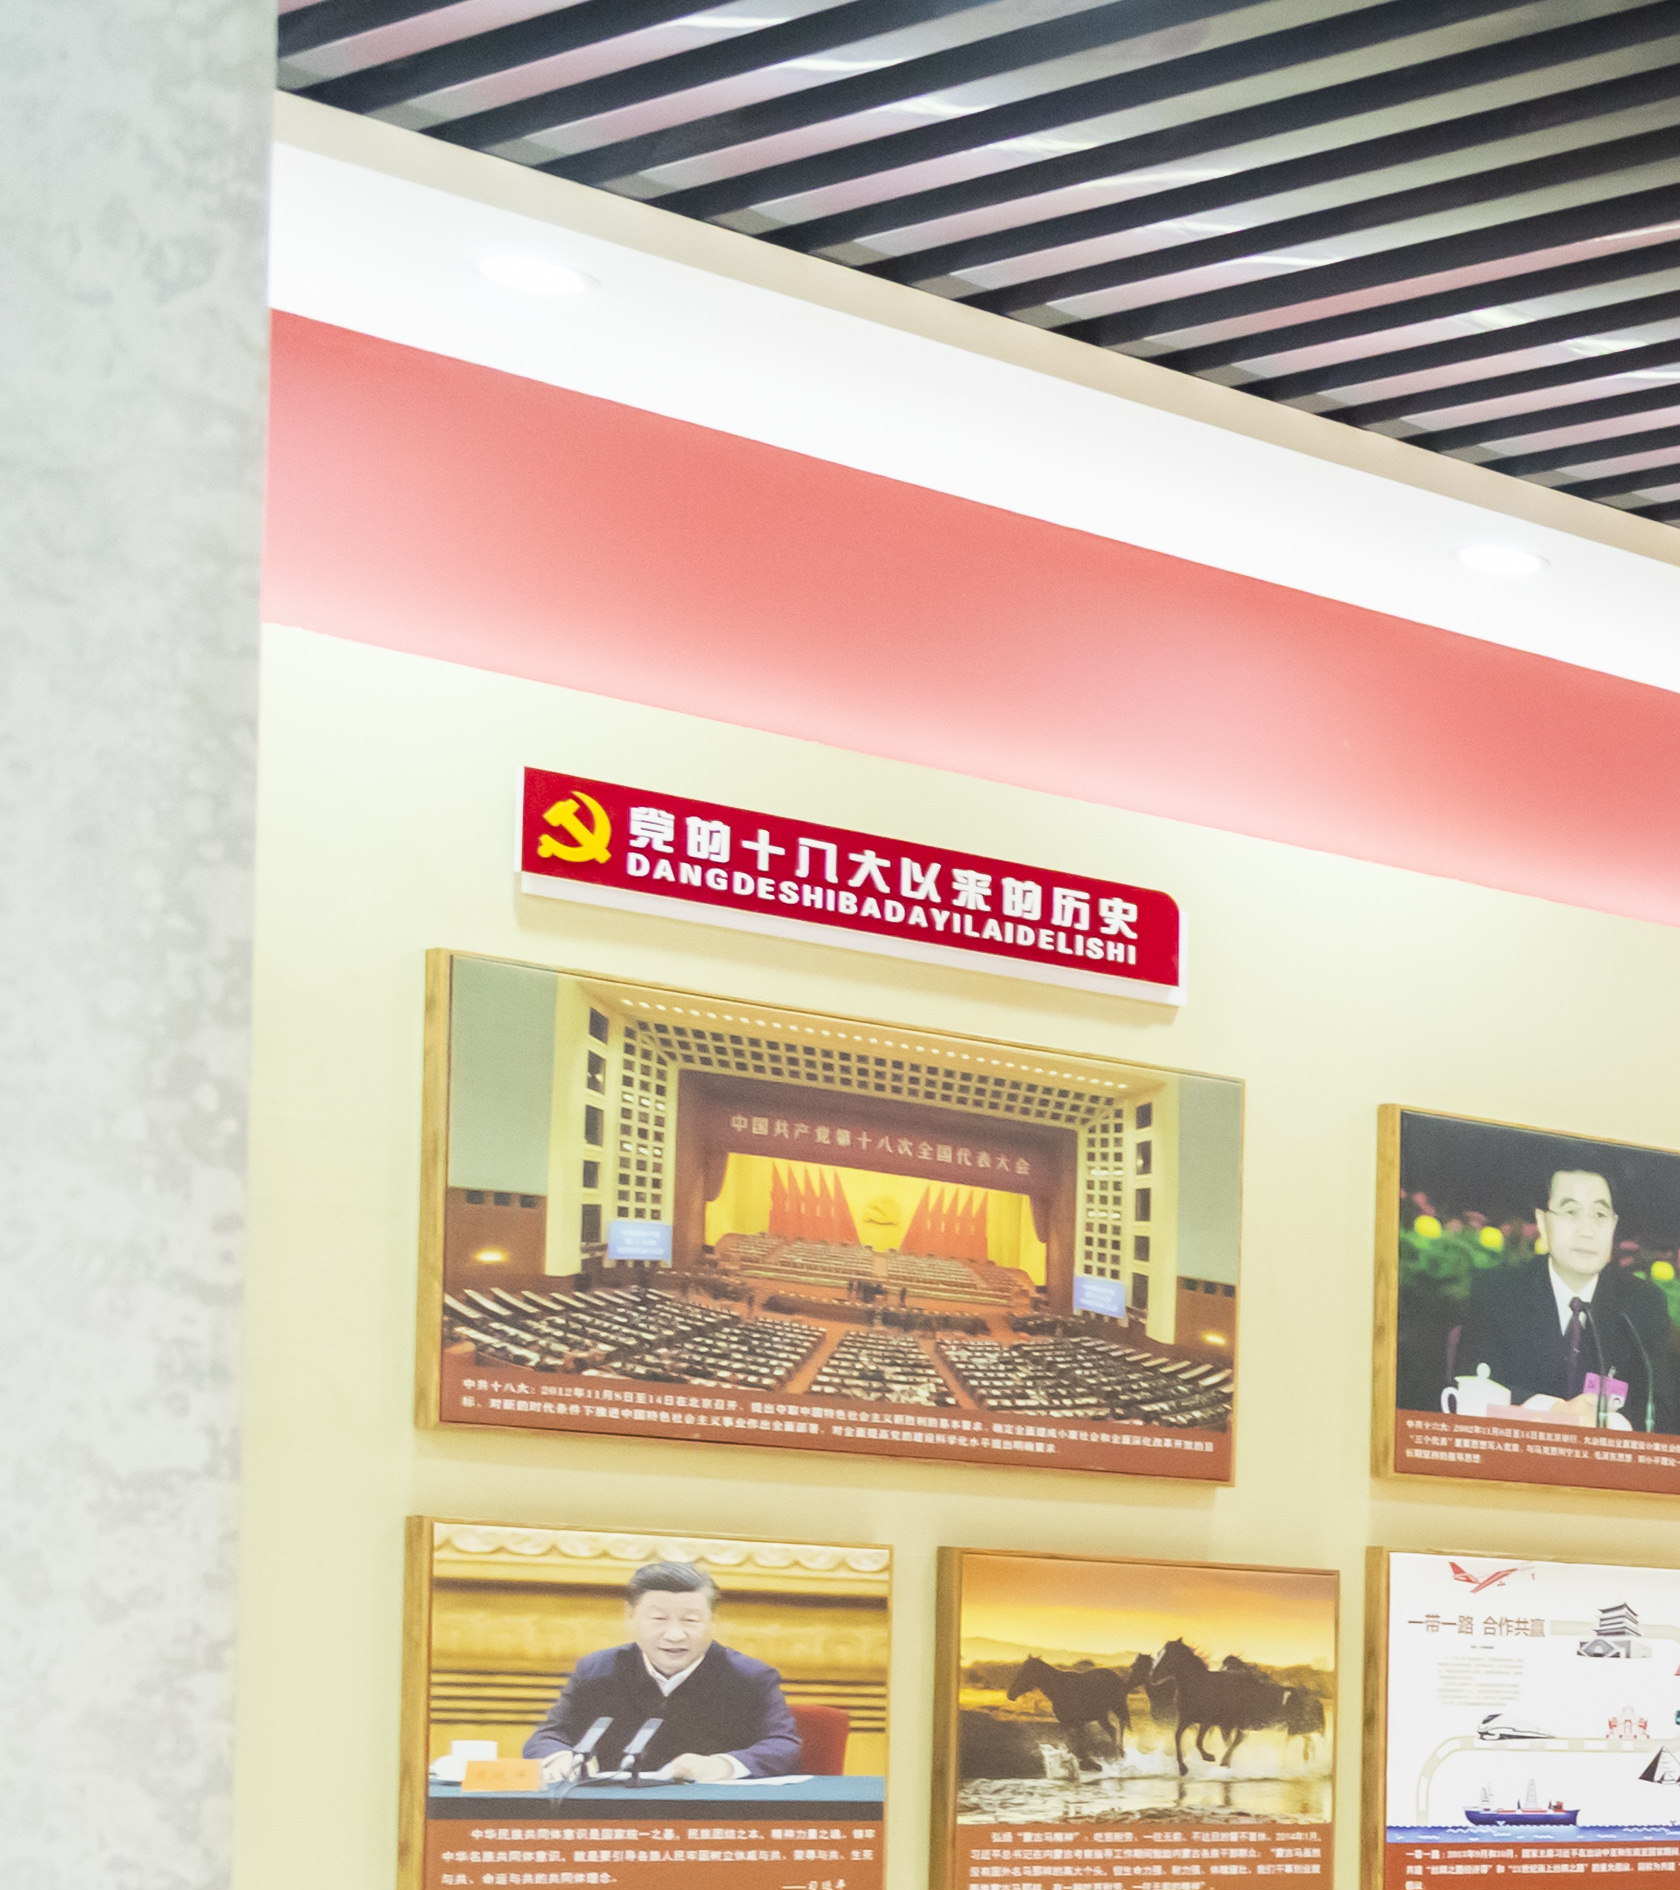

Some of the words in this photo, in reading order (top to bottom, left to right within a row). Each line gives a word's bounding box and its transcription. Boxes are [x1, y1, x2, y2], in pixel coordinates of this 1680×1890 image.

[627, 853, 1138, 965] DANGDESHIBADAYILAIDELISHI
[628, 806, 1139, 940] 党的十八大以来的历史
[1407, 1614, 1474, 1635] 一带一路
[1482, 1615, 1546, 1638] 合作共赢
